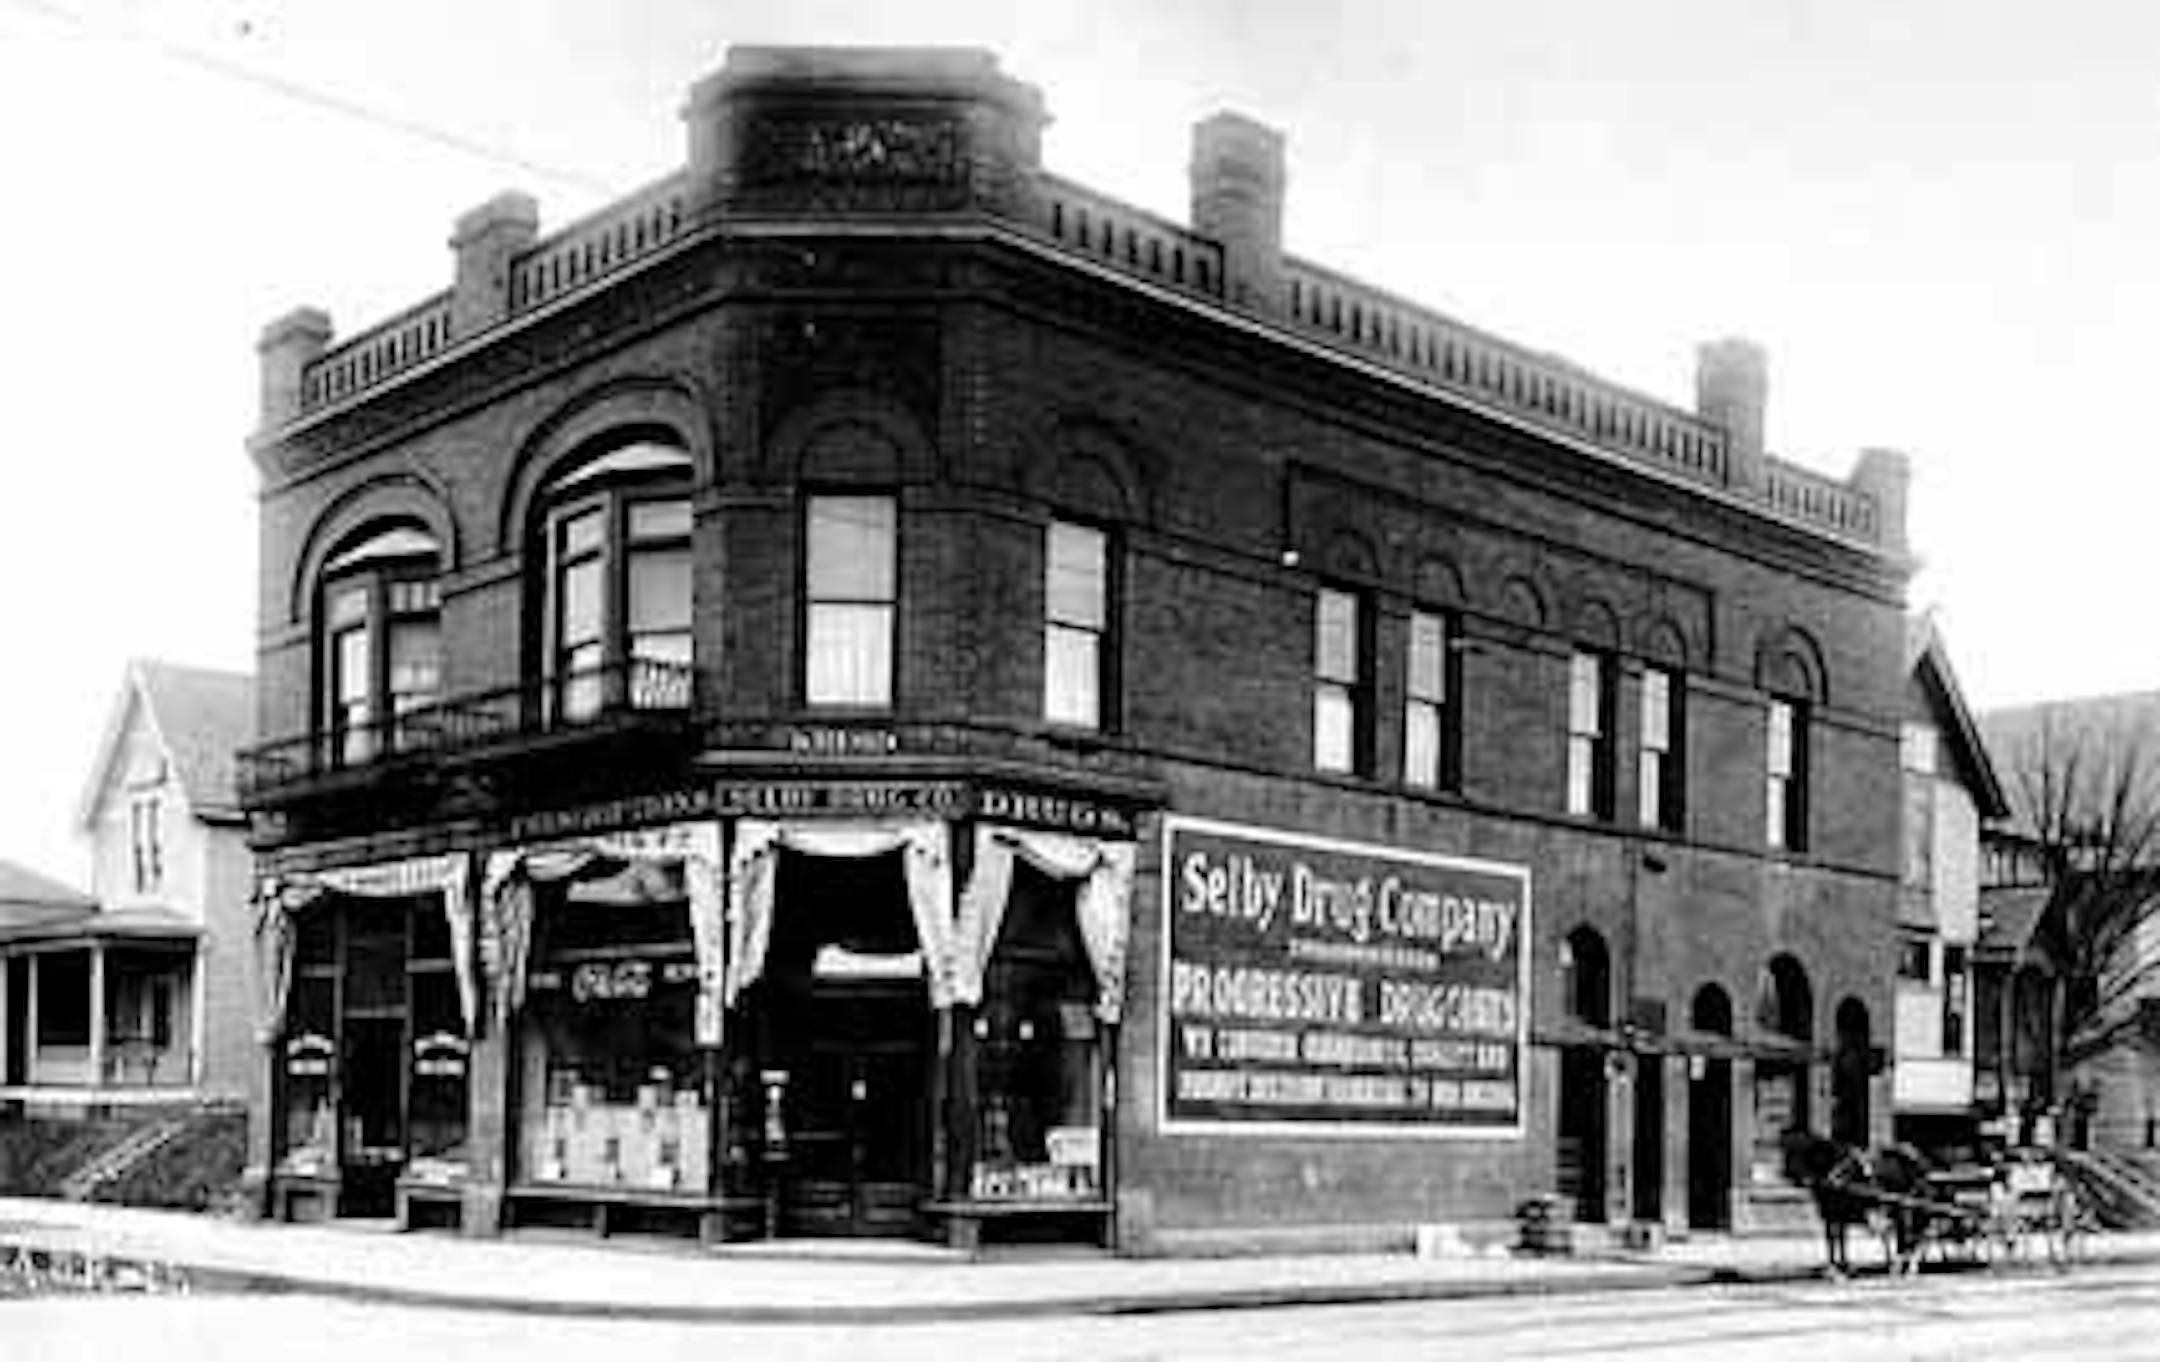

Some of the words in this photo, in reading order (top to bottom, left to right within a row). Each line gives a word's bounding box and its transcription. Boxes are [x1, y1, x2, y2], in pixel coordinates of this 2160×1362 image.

[1182, 851, 1284, 931] Selby
[1292, 861, 1373, 942] Drug
[1380, 875, 1516, 962] Company
[1172, 958, 1363, 1025] PROGRESSIVE
